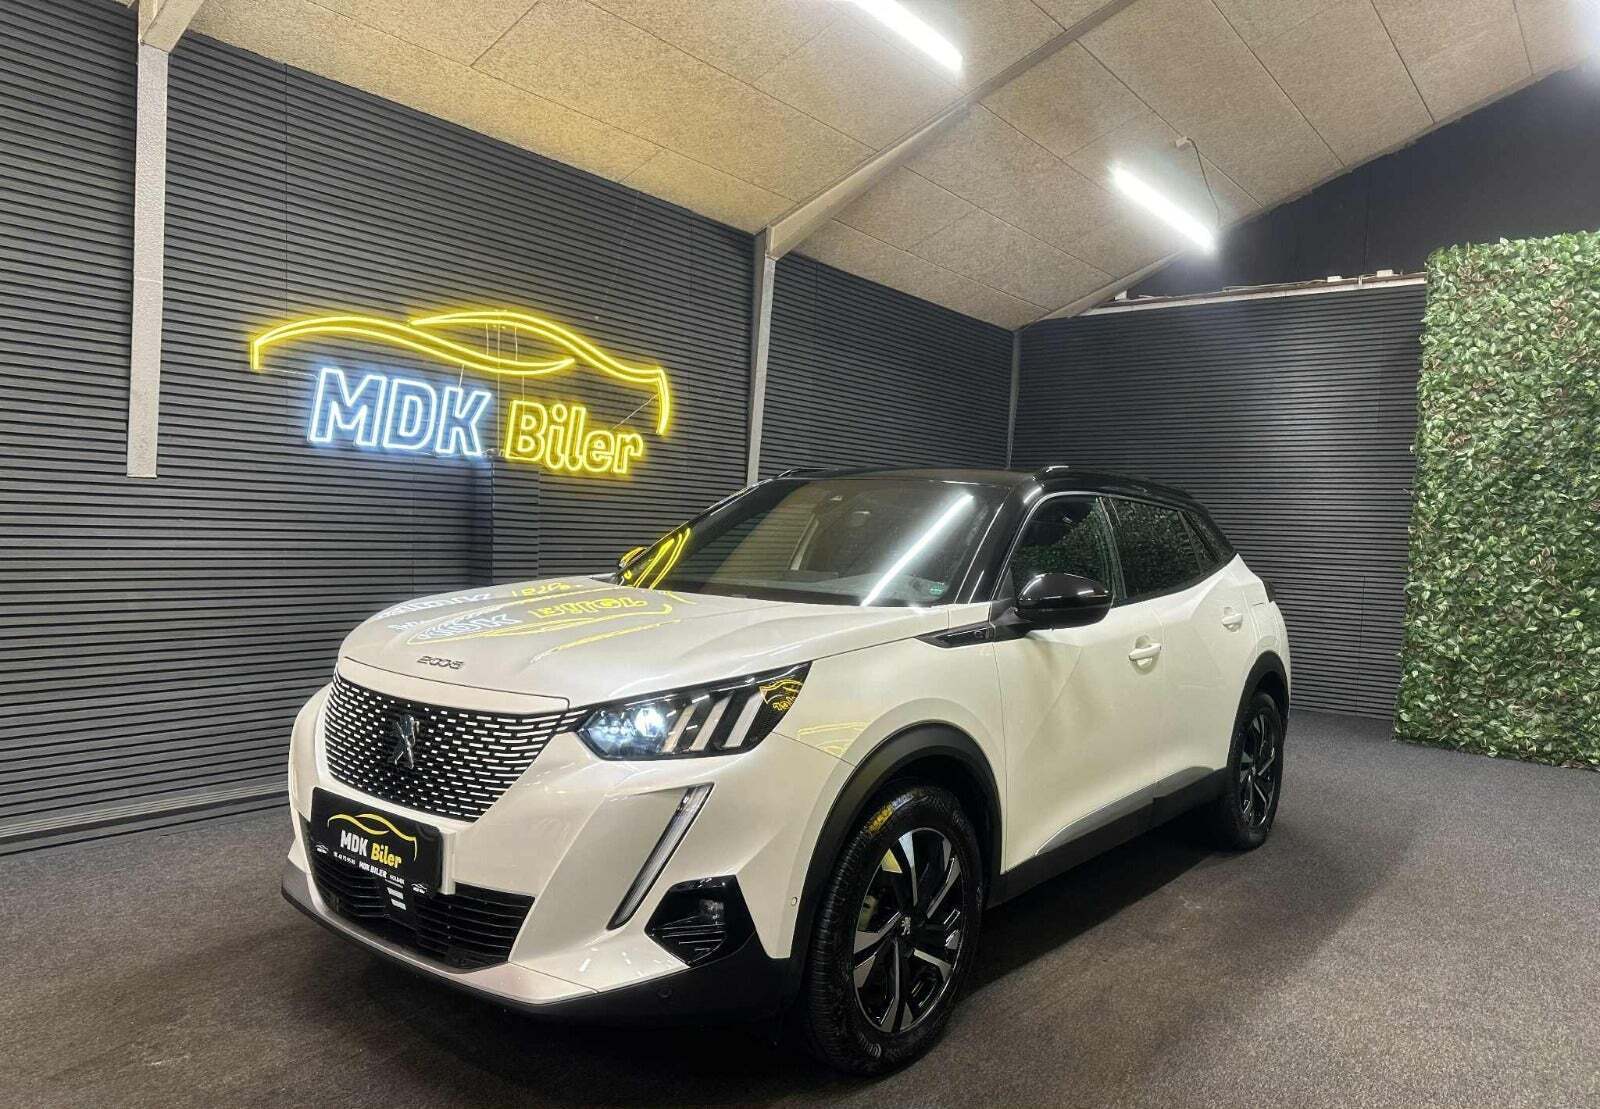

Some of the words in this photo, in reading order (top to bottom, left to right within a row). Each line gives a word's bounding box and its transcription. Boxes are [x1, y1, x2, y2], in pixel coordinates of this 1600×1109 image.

[308, 367, 492, 457] MDK
[504, 400, 643, 474] Biler
[340, 829, 368, 857] MDK
[370, 842, 402, 868] Biler
